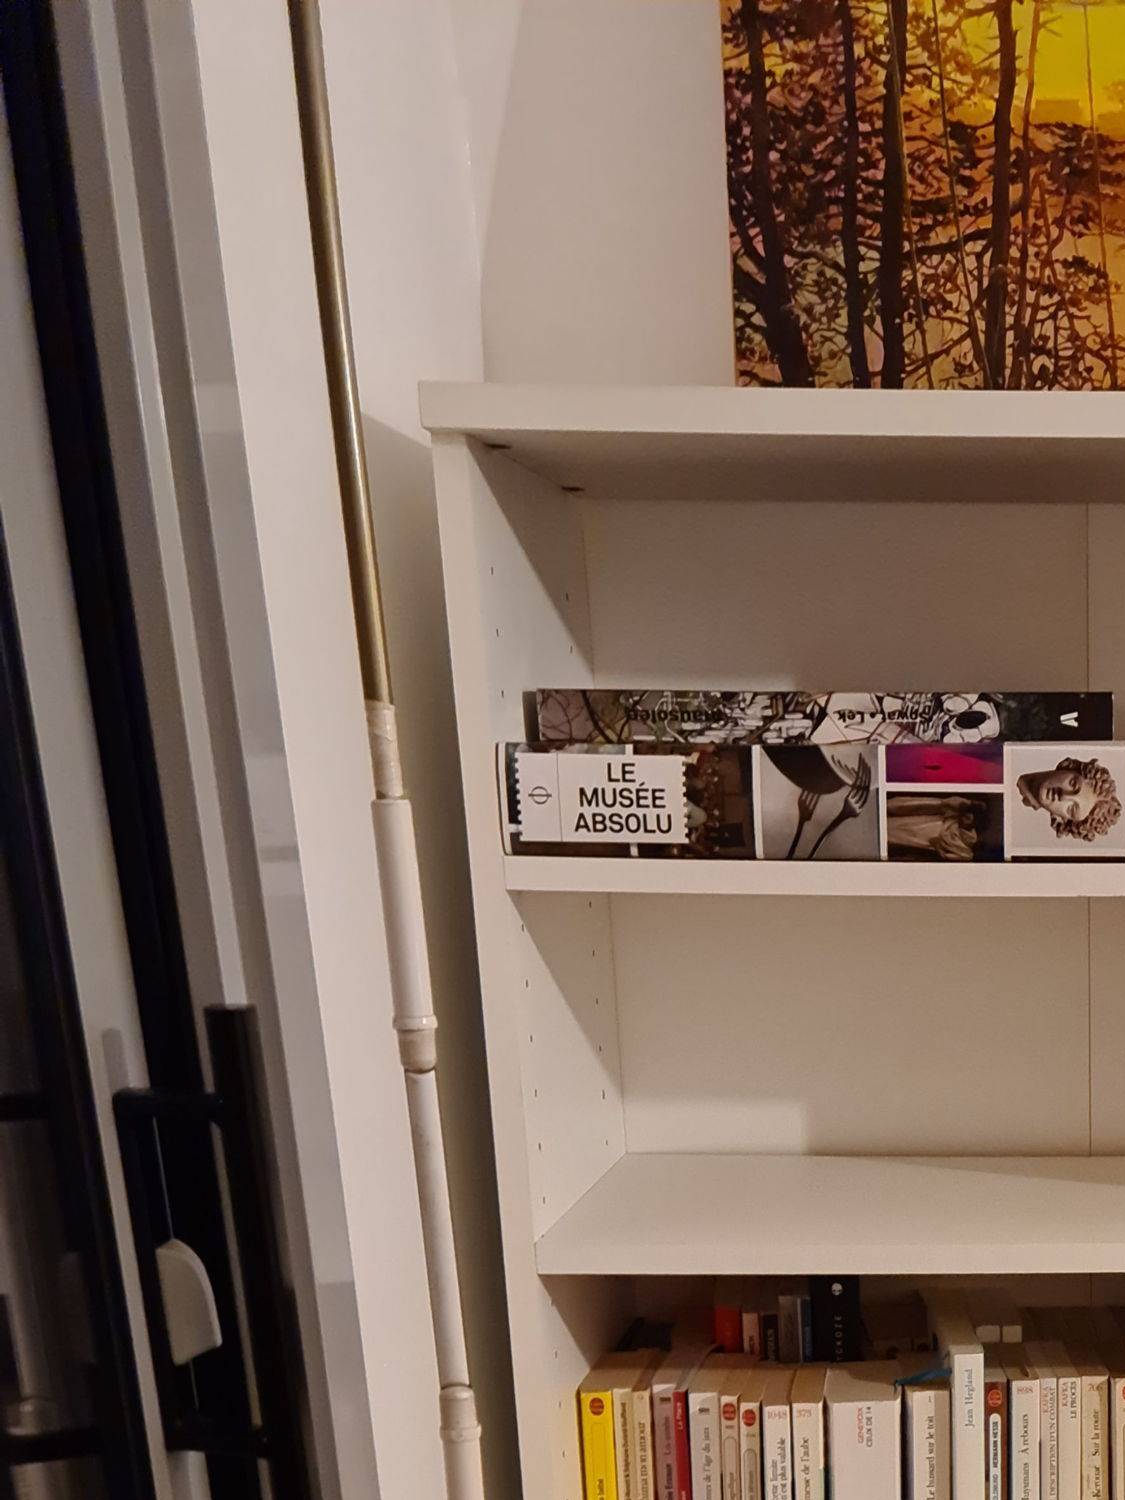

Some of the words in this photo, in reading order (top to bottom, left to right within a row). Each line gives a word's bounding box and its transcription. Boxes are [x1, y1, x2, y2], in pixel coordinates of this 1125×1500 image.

[606, 761, 636, 784] LE
[577, 781, 667, 811] MUSÉE
[573, 809, 673, 835] ABSOLU
[964, 1368, 975, 1405] Hegland
[965, 1408, 975, 1428] Jean
[1091, 1432, 1100, 1441] la
[1091, 1442, 1100, 1457] Sur
